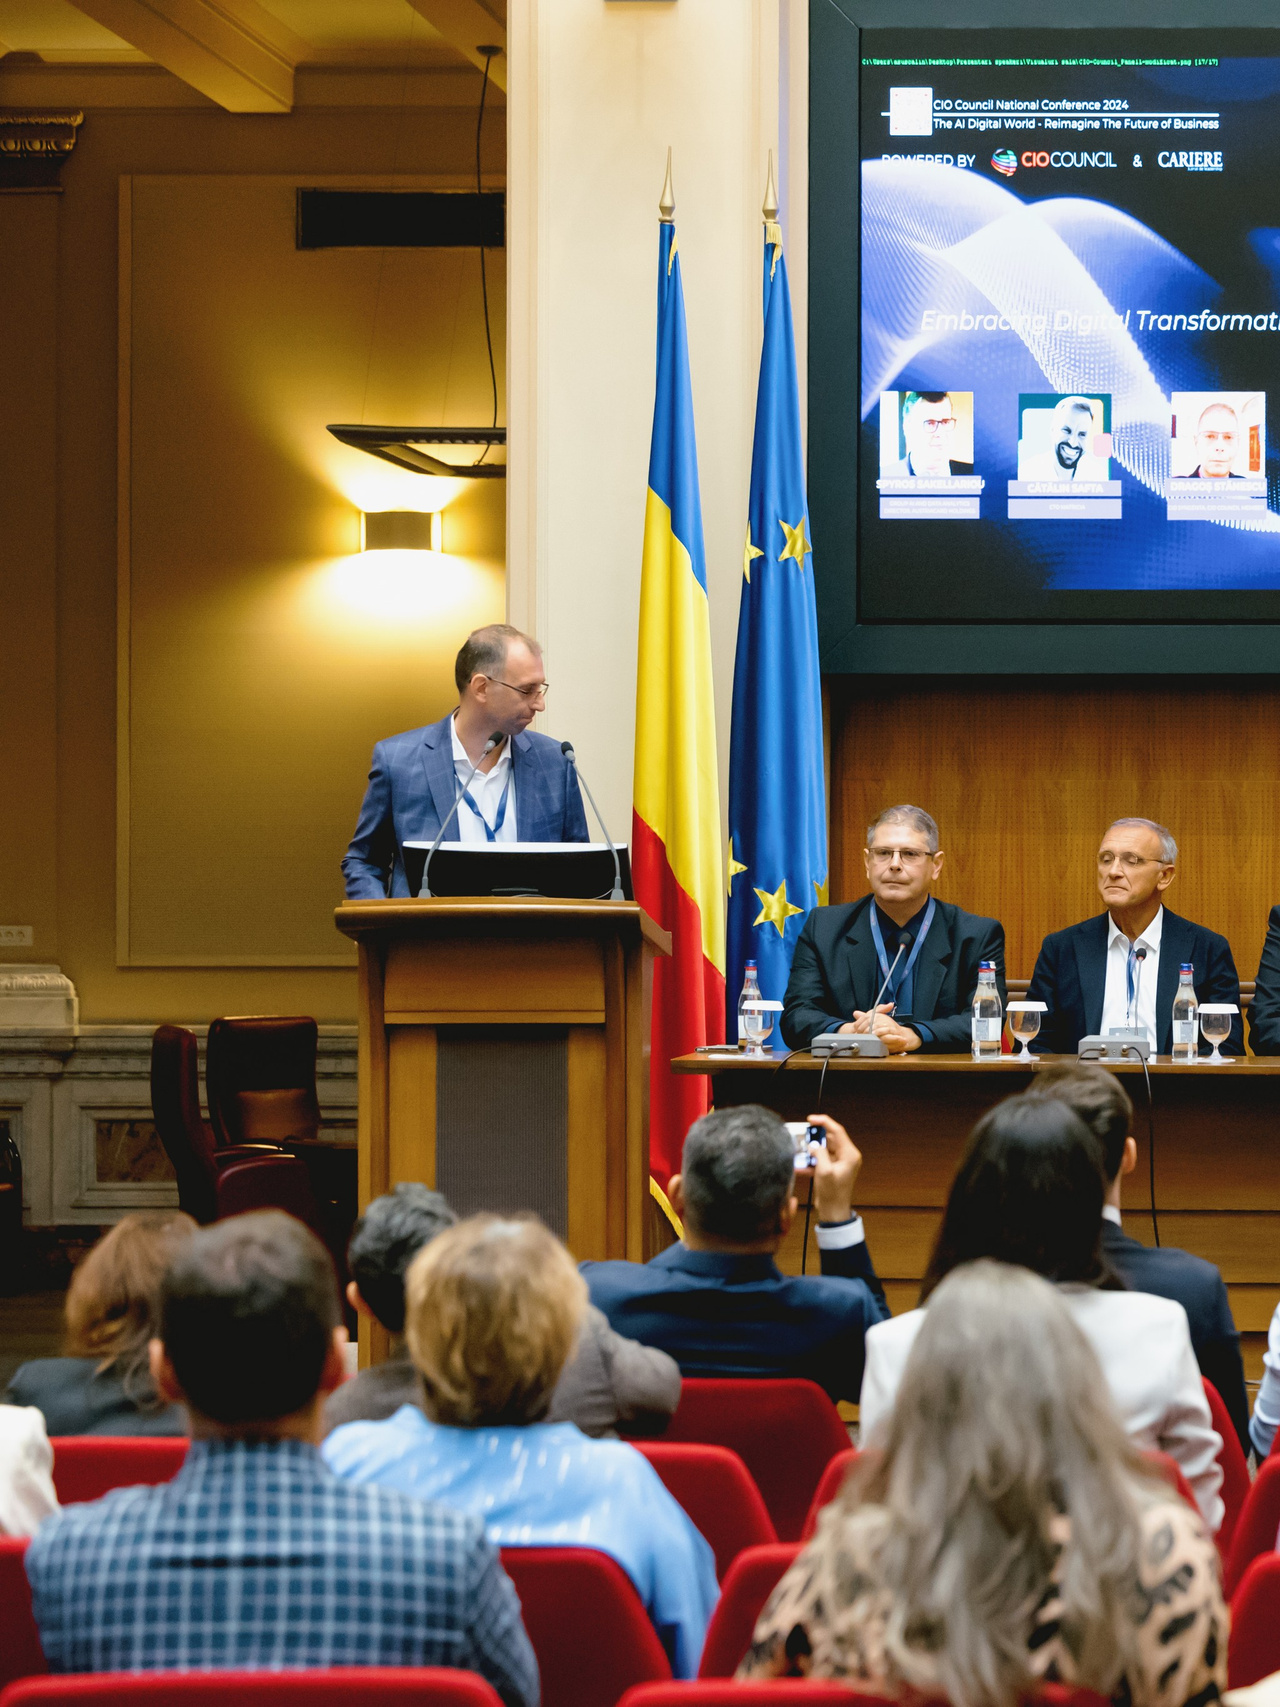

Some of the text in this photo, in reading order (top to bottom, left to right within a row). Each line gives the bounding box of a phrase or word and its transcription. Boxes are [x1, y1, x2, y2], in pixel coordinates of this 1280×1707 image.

[1194, 58, 1219, 67] [17/17]
[933, 99, 1130, 111] CIO Council National Conference 2024
[933, 118, 953, 129] The
[954, 118, 966, 129] AI
[968, 118, 1002, 131] Digital
[1004, 118, 1036, 129] World
[1044, 118, 1101, 132] Reimagine
[1102, 118, 1122, 129] The
[1124, 118, 1159, 129] Future
[1160, 118, 1172, 129] of
[1173, 118, 1220, 129] Business
[881, 154, 976, 168] POWERED BY
[1132, 154, 1143, 168] &
[1157, 151, 1224, 168] CARIERE
[920, 309, 1048, 336] Embracing
[1053, 309, 1131, 336] Digital
[876, 479, 916, 489] SPYROS
[1071, 483, 1104, 493] SAFTA
